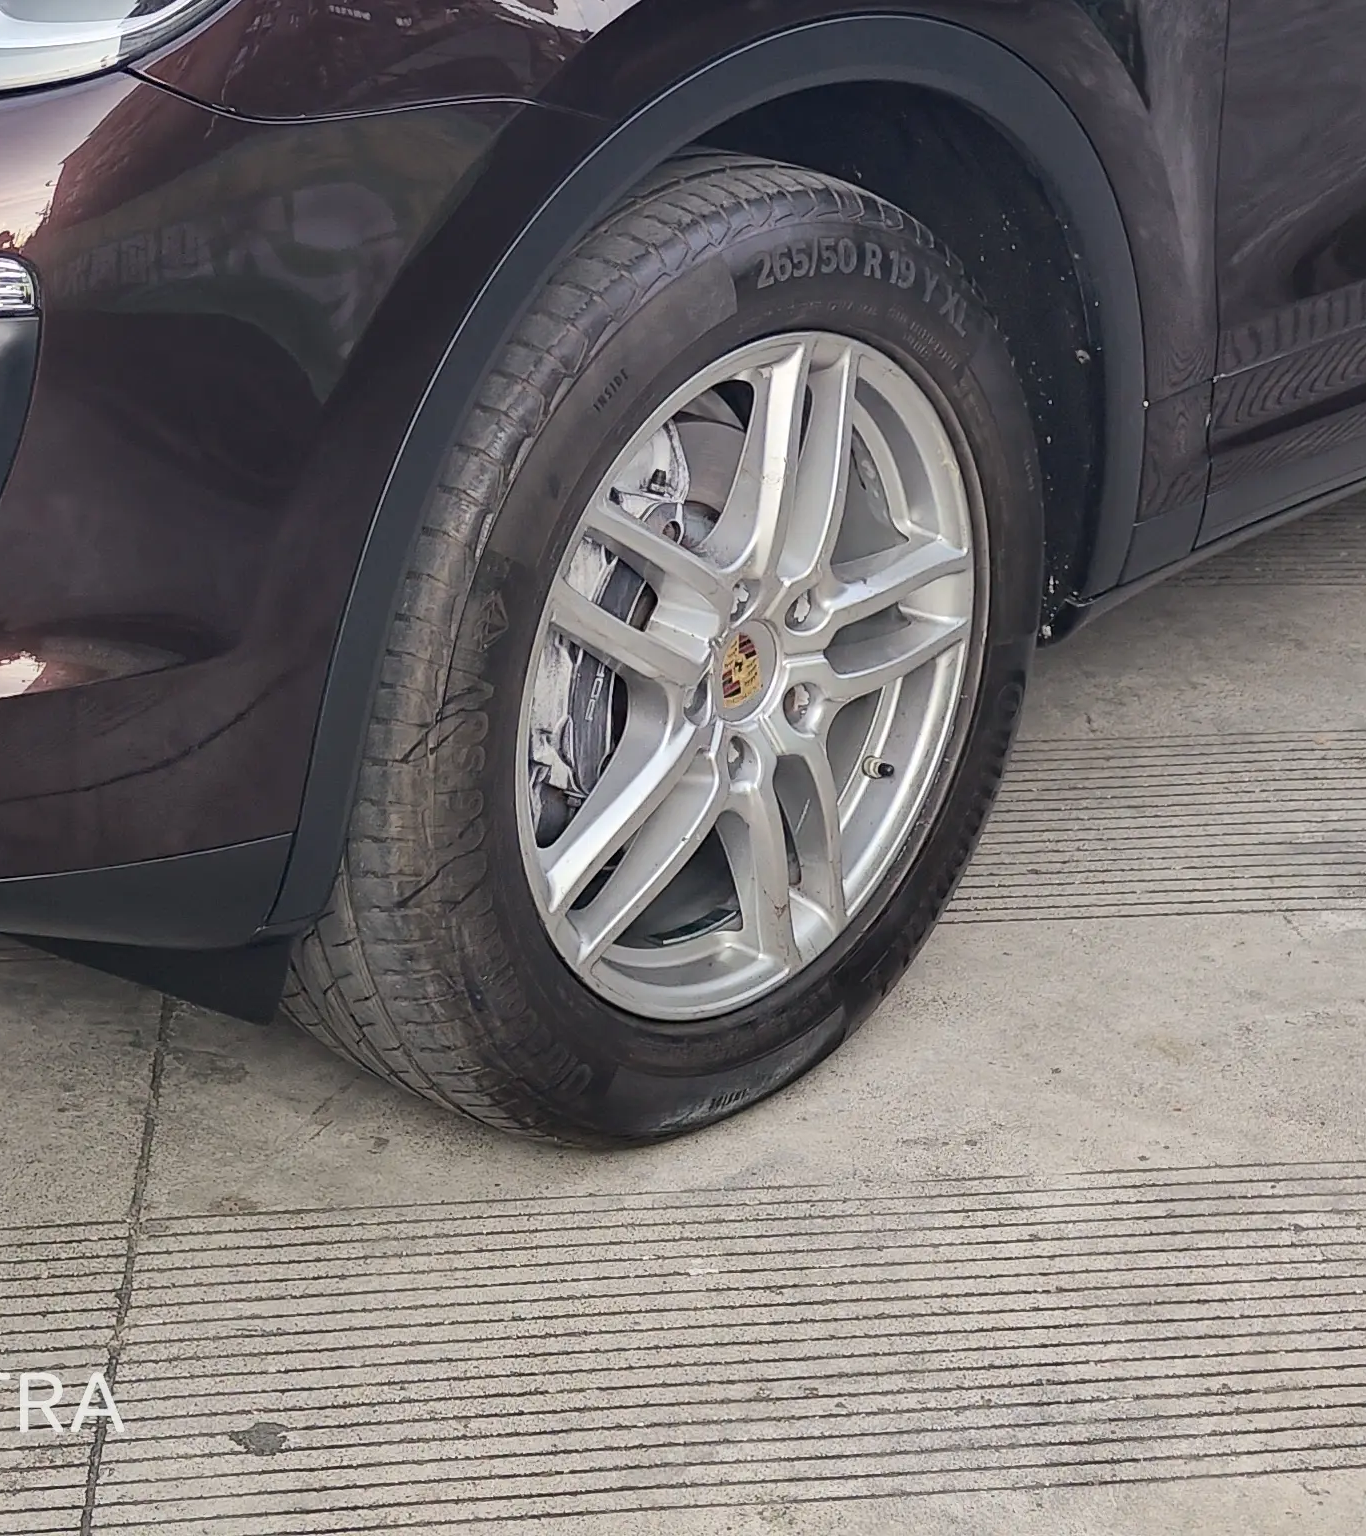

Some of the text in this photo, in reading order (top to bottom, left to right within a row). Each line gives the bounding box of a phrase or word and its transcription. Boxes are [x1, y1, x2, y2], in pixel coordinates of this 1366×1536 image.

[756, 237, 857, 289] 265/50
[863, 242, 882, 280] R
[889, 249, 916, 290] 19
